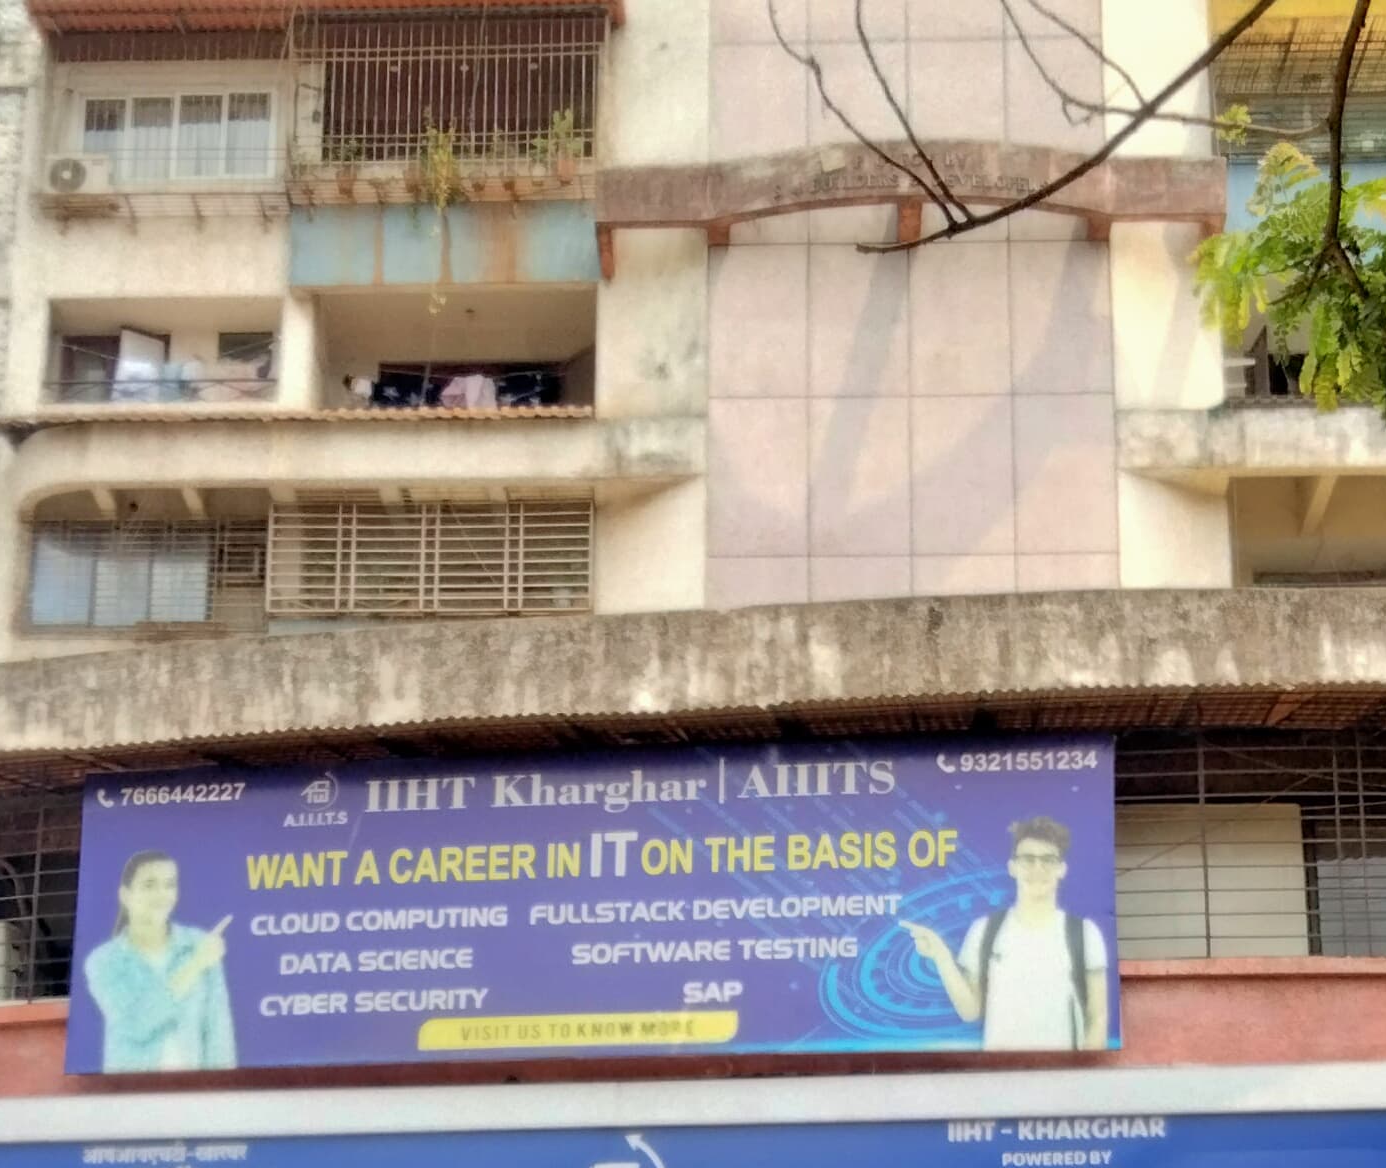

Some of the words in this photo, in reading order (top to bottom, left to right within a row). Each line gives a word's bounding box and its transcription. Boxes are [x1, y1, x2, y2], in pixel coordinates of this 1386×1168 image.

[960, 751, 1098, 772] 9321551234
[120, 782, 245, 808] 7666442227
[365, 776, 475, 812] IIHT
[490, 769, 708, 813] Kharghar
[737, 759, 896, 799] AIIITS
[247, 850, 349, 890] WANT
[355, 849, 381, 886] A
[389, 843, 536, 884] CAREER
[547, 842, 581, 878] IN
[590, 831, 637, 878] IT
[641, 838, 694, 875] ON
[705, 834, 775, 873] THE
[787, 831, 897, 871] BASIS
[908, 829, 958, 868] OF
[250, 910, 341, 937] CLOUD
[346, 905, 509, 933] COMPUTING
[529, 898, 685, 926] FULLSTACK
[693, 894, 903, 921] DEVELOPMENT
[280, 951, 352, 975] DATA
[358, 948, 474, 972] SCIENCE
[571, 940, 731, 967] SOFTWARE
[737, 937, 859, 960] TESTING
[260, 992, 347, 1018] CYBER
[355, 988, 490, 1013] SECURITY
[683, 982, 743, 1005] SAP
[461, 1023, 511, 1041] VISIT
[517, 1024, 541, 1040] US
[549, 1022, 571, 1039] TO
[576, 1020, 633, 1038] KNOW
[947, 1121, 995, 1142] IIHT
[1018, 1117, 1166, 1141] KHARGHAR
[1002, 1152, 1086, 1166] POWERED
[1090, 1151, 1112, 1165] BY
